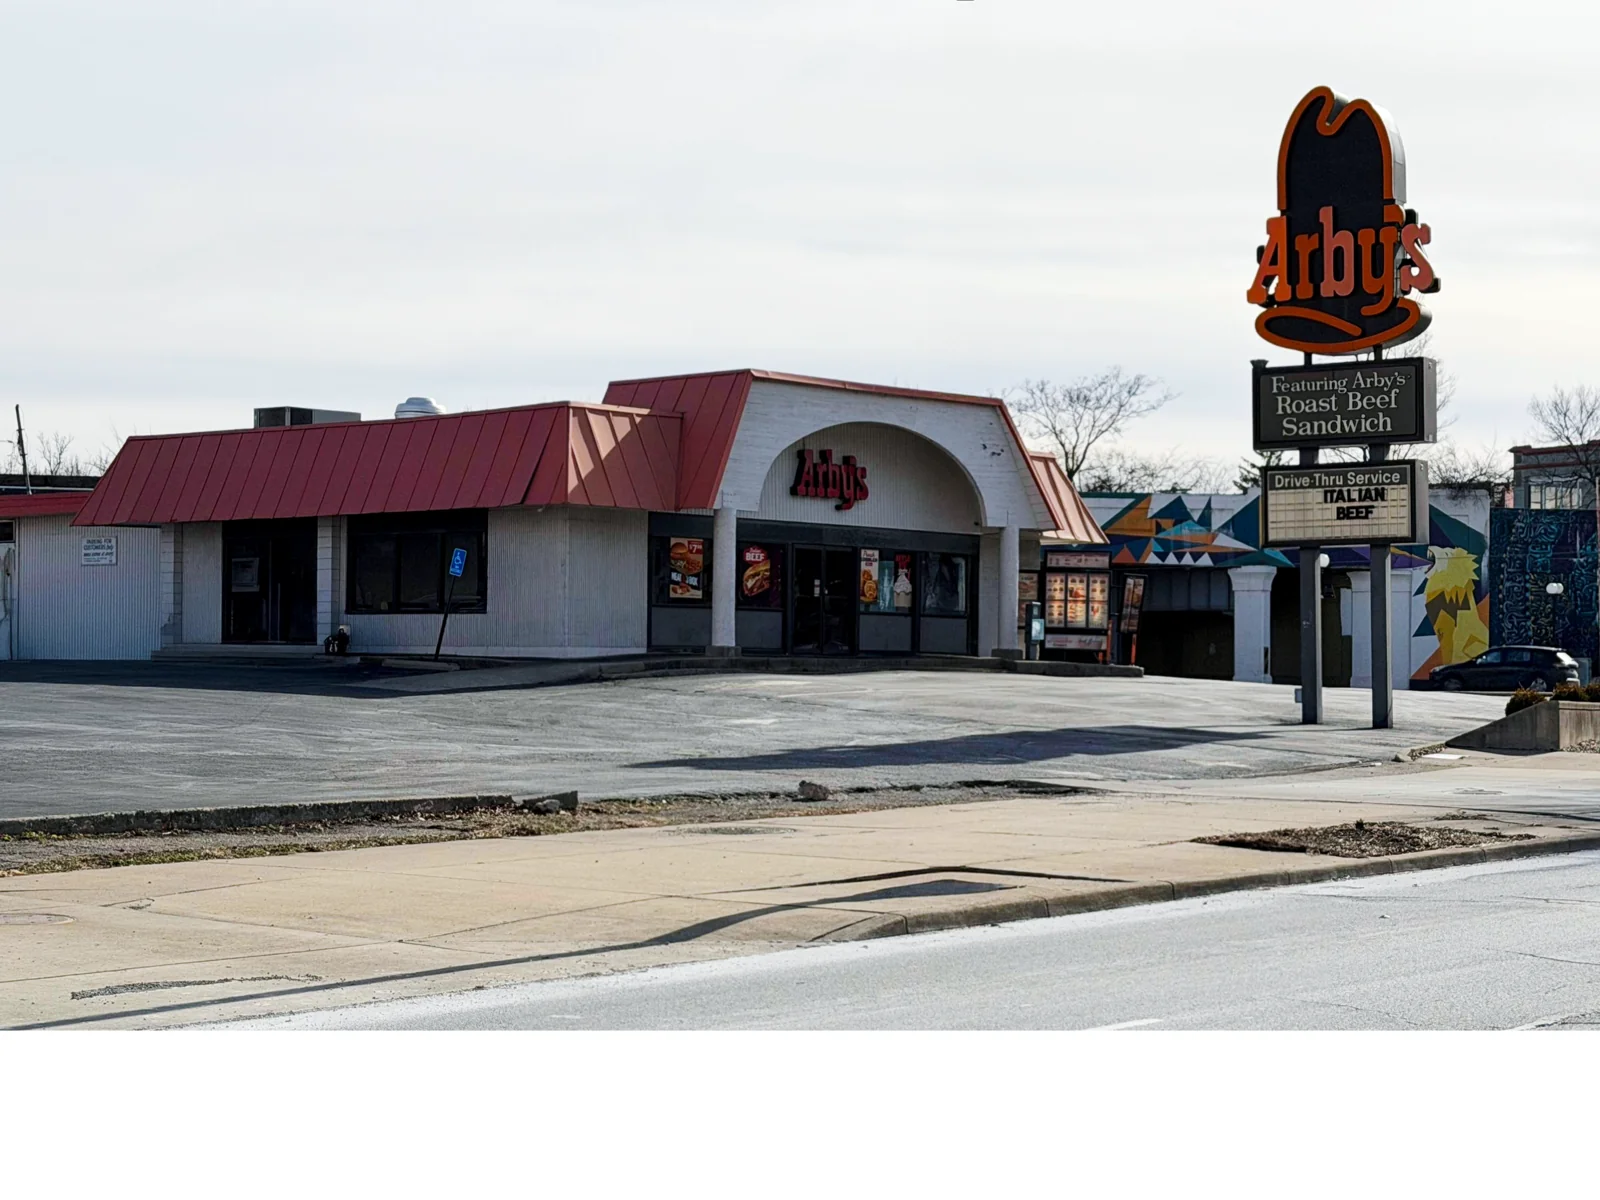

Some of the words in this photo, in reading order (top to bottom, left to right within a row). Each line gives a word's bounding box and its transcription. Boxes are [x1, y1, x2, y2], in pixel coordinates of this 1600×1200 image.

[1247, 205, 1433, 316] Arby's
[1271, 375, 1348, 393] Featuring
[1352, 371, 1406, 392] Arby's
[1276, 394, 1339, 415] Roast
[1347, 388, 1399, 411] Beef
[1282, 412, 1392, 436] Sandwich
[1347, 470, 1401, 485] Service
[1323, 487, 1386, 504] ITALIAN
[1336, 505, 1375, 520] BEEF
[745, 552, 765, 561] BEEF
